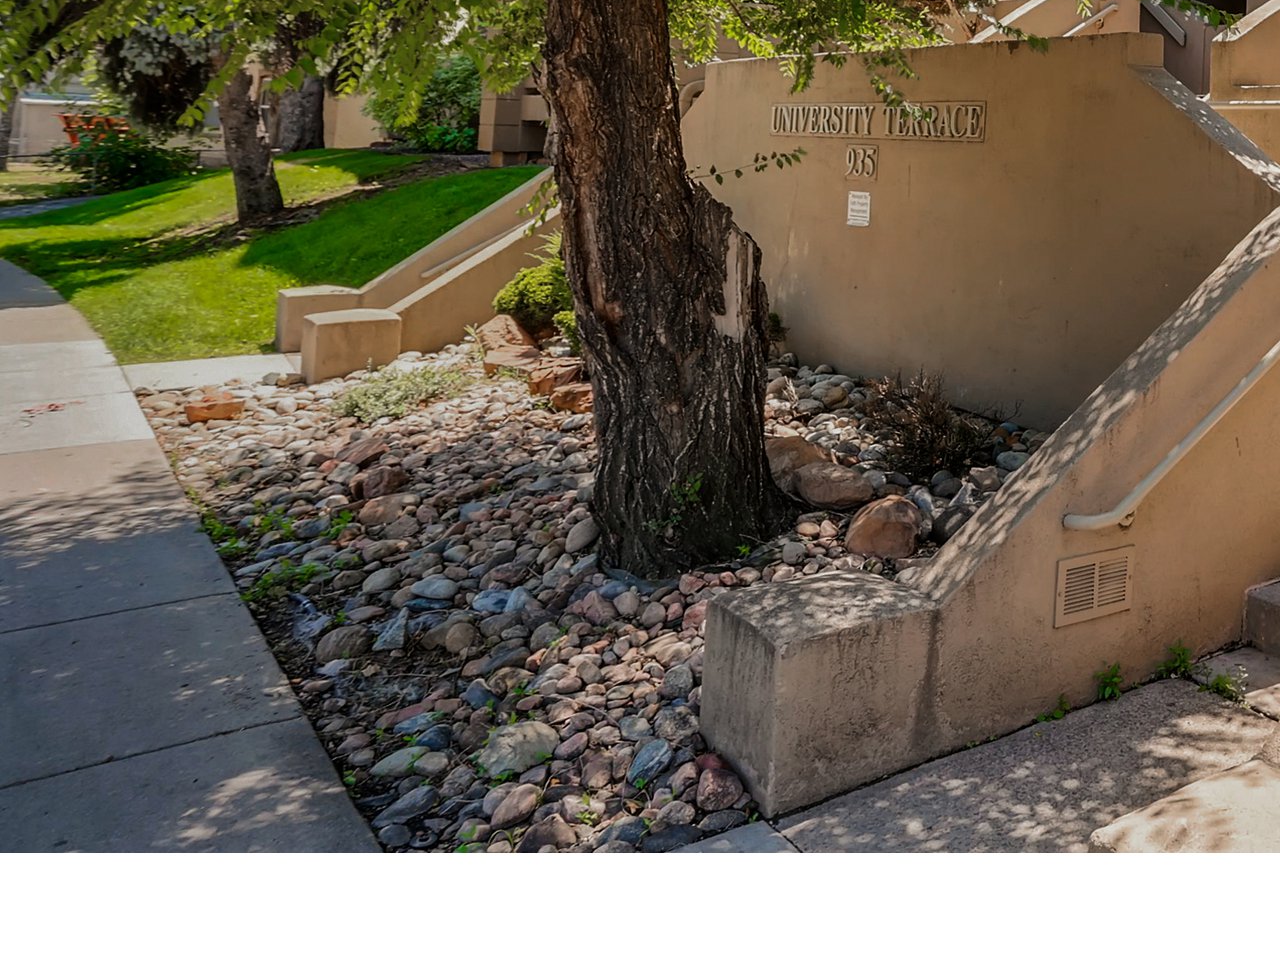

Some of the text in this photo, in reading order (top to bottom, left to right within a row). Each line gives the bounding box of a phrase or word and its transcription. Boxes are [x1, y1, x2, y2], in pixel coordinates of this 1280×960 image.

[771, 105, 983, 138] UNIVERSITY TERRACE
[845, 148, 875, 176] 935
